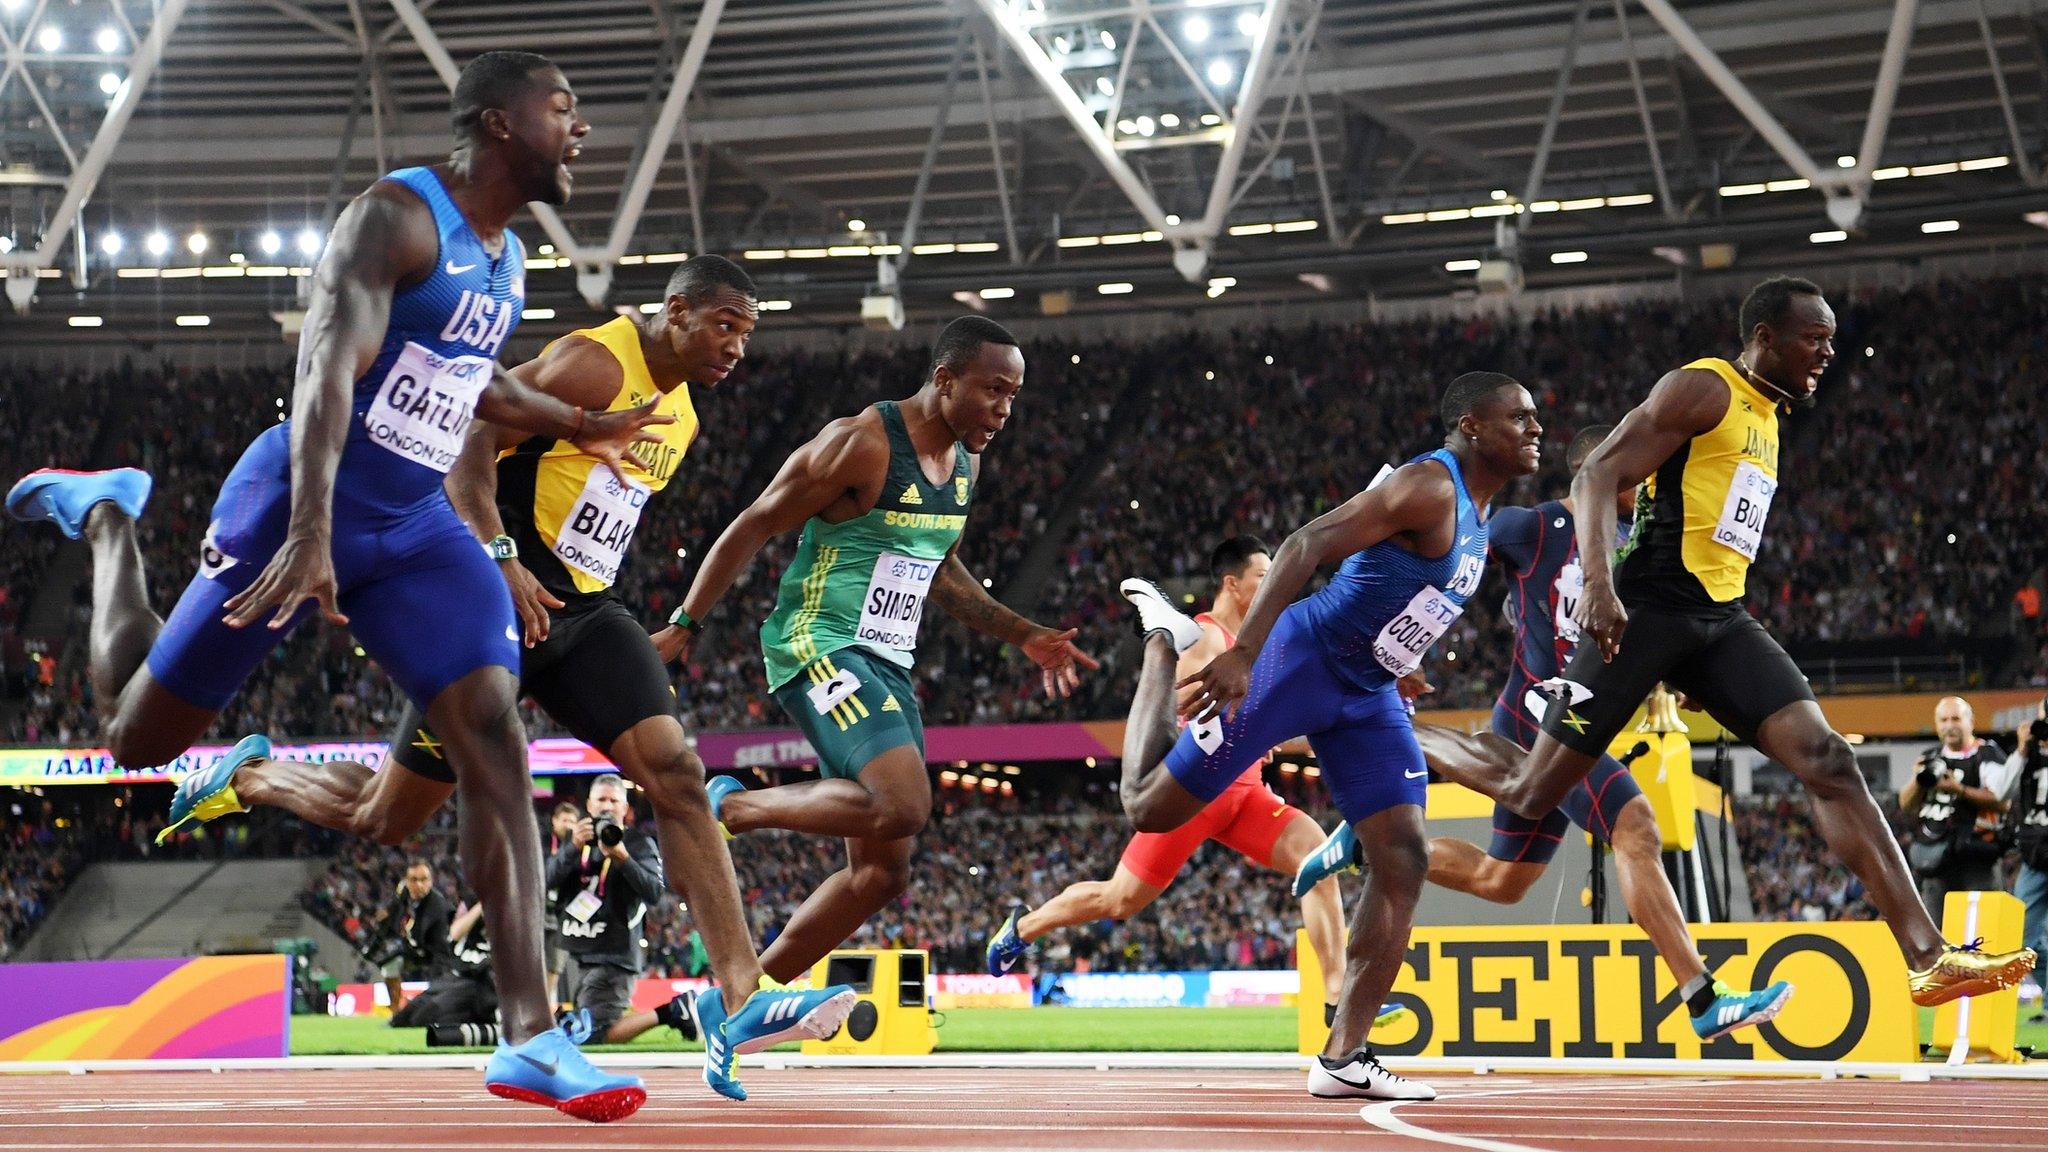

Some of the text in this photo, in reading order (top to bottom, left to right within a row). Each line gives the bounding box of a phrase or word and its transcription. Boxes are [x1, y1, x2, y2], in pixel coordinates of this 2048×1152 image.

[440, 289, 512, 355] USA
[367, 419, 436, 460] LONDON
[620, 485, 645, 509] TD
[571, 501, 636, 554] BLAK
[1734, 497, 1760, 534] BOL
[557, 541, 606, 577] LONDON
[909, 562, 934, 581] TD
[1564, 596, 1577, 618] V
[860, 626, 906, 646] LONDON
[44, 756, 109, 776] IAAF
[1371, 933, 1871, 1061] SEIKO
